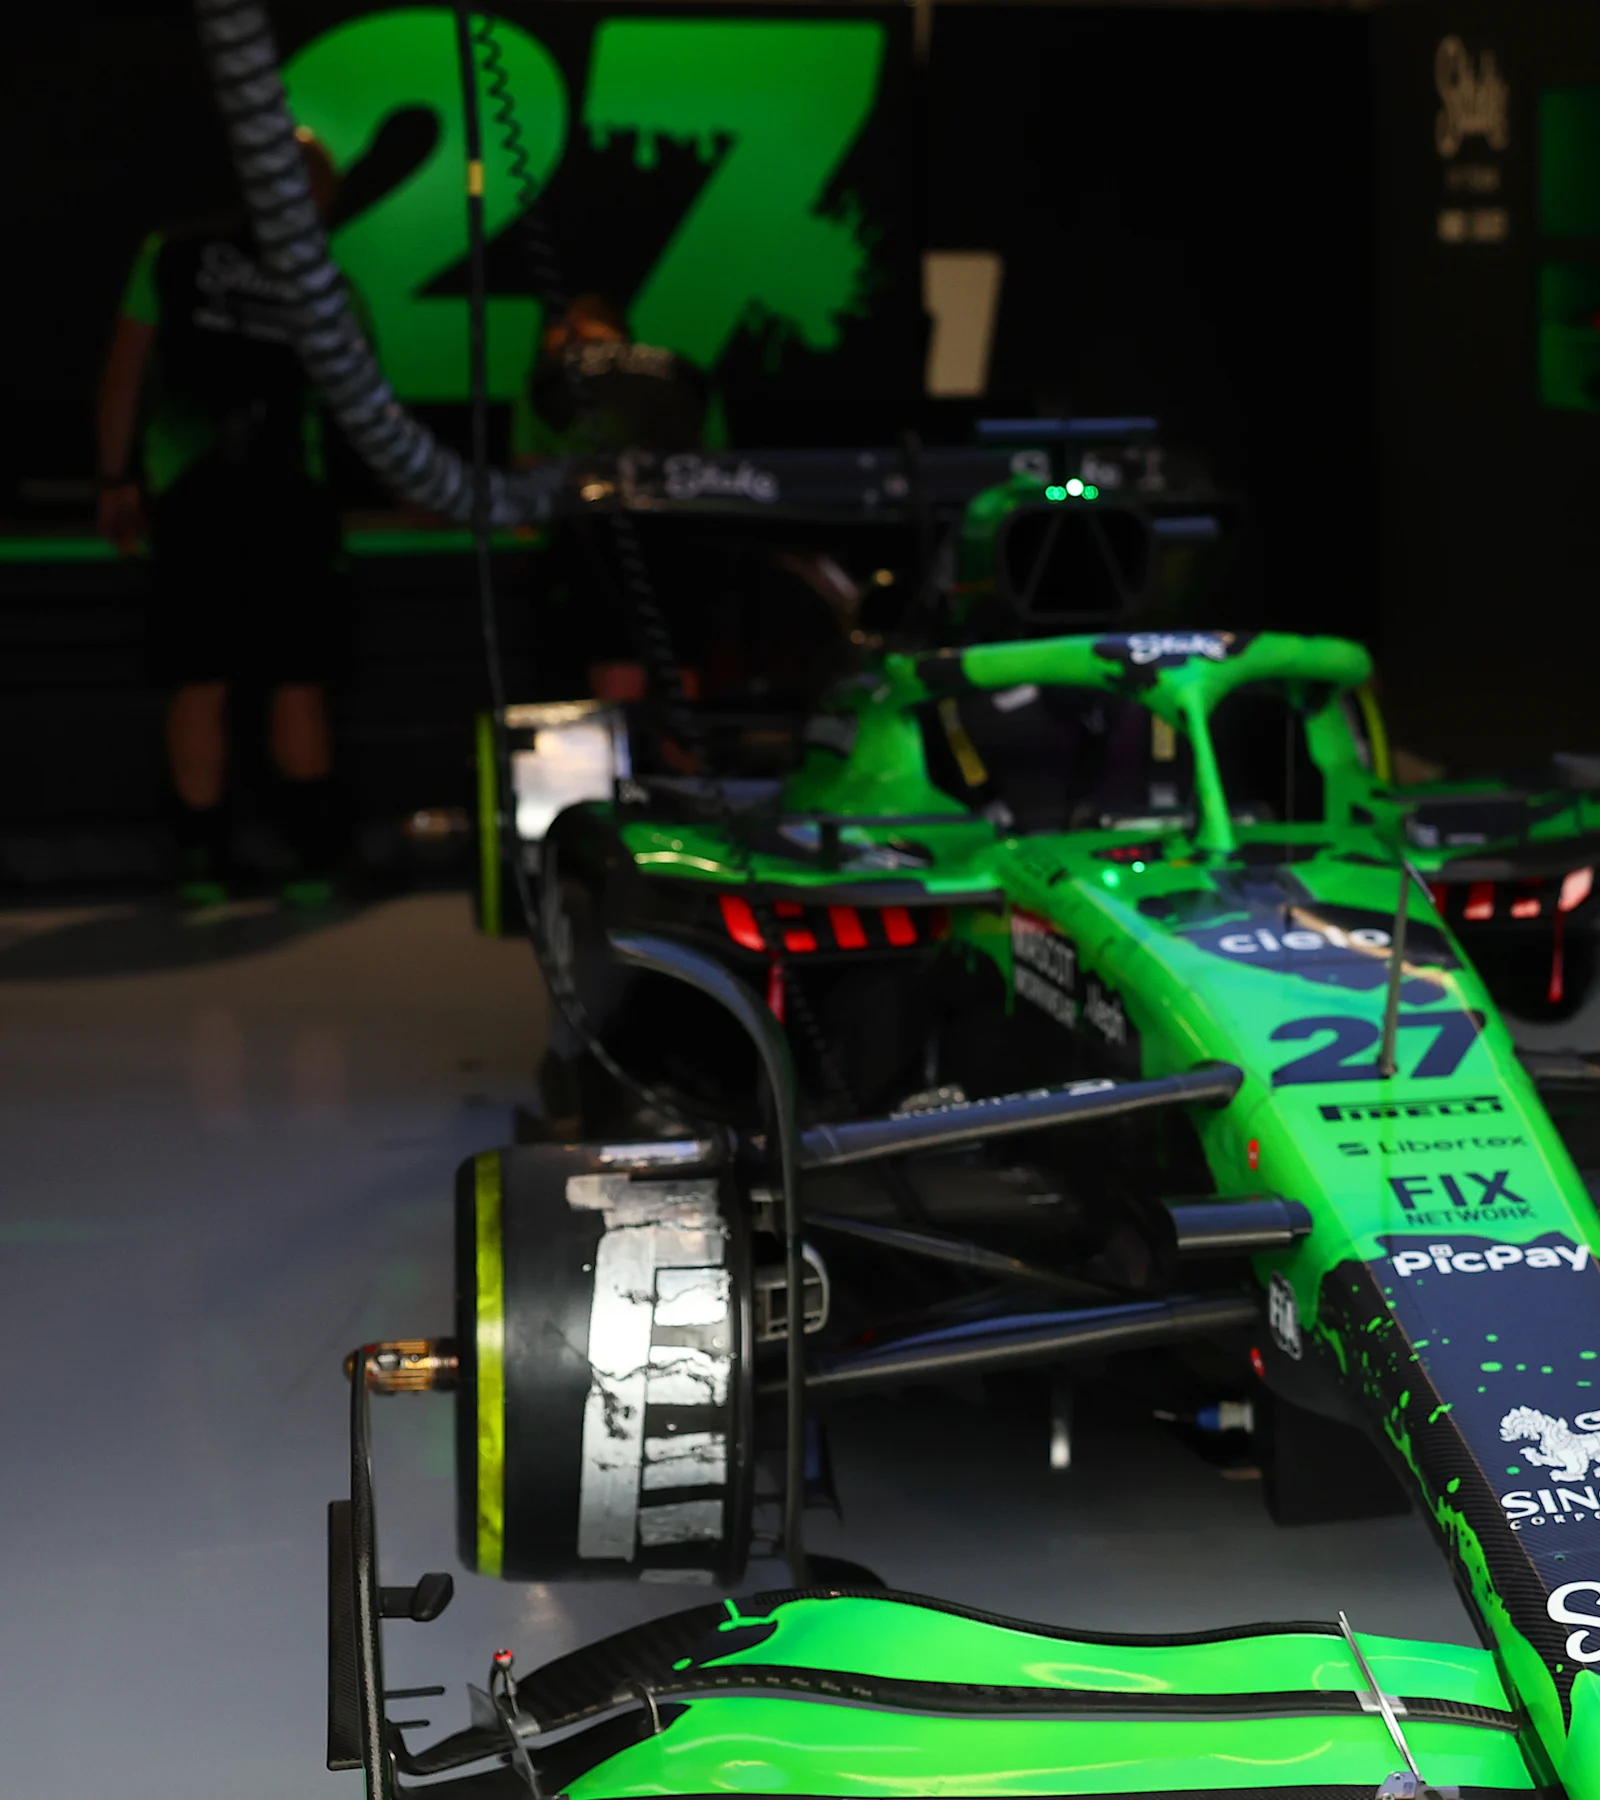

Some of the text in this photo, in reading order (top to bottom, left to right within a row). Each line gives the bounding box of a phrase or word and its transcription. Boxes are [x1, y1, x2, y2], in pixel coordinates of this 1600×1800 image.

[281, 6, 886, 400] 27
[1219, 925, 1392, 953] cielo
[1268, 1009, 1487, 1087] 27
[1317, 1096, 1504, 1122] PIRELLI
[1378, 1133, 1528, 1156] Libertex
[1388, 1169, 1528, 1211] FIX
[1404, 1206, 1537, 1227] NETWORK
[1391, 1244, 1590, 1277] PicPay
